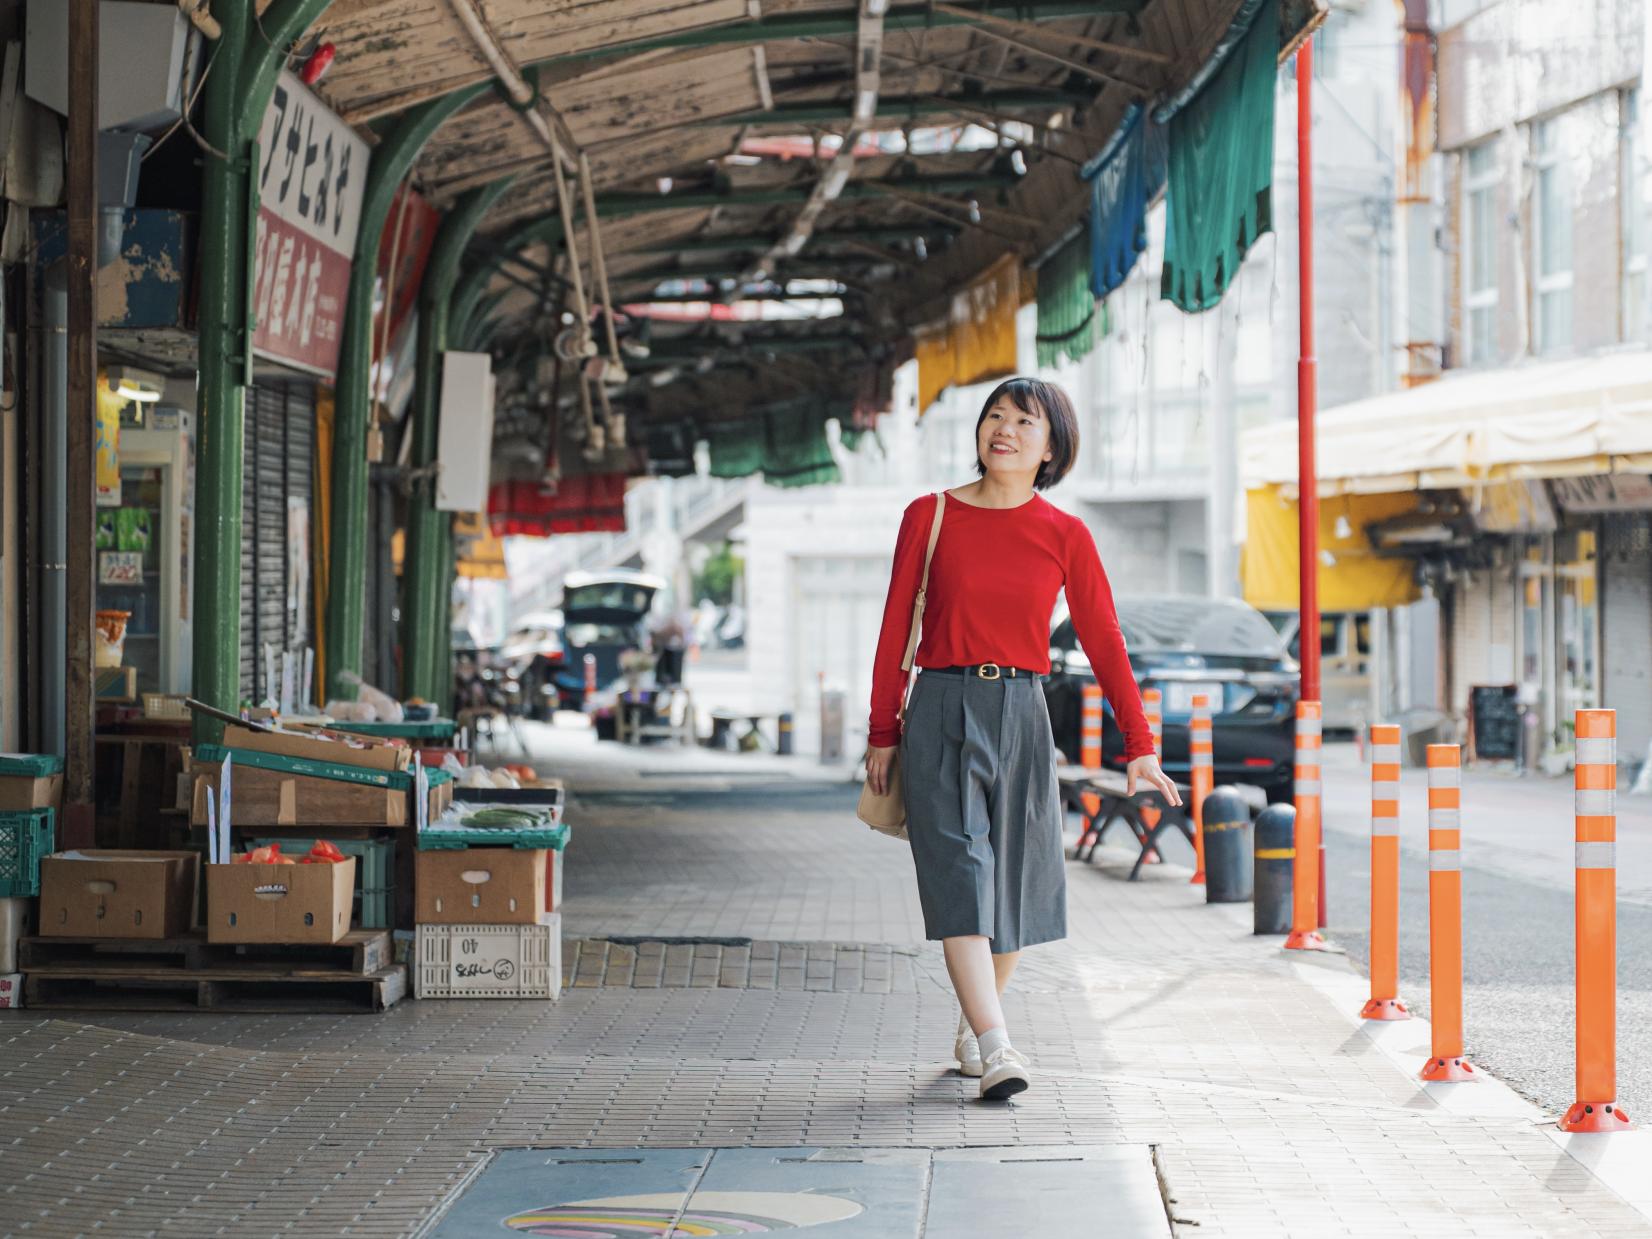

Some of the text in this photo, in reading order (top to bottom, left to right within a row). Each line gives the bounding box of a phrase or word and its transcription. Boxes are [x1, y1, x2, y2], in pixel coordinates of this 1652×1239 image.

[462, 938, 479, 954] 40
[455, 963, 492, 978] つがる
